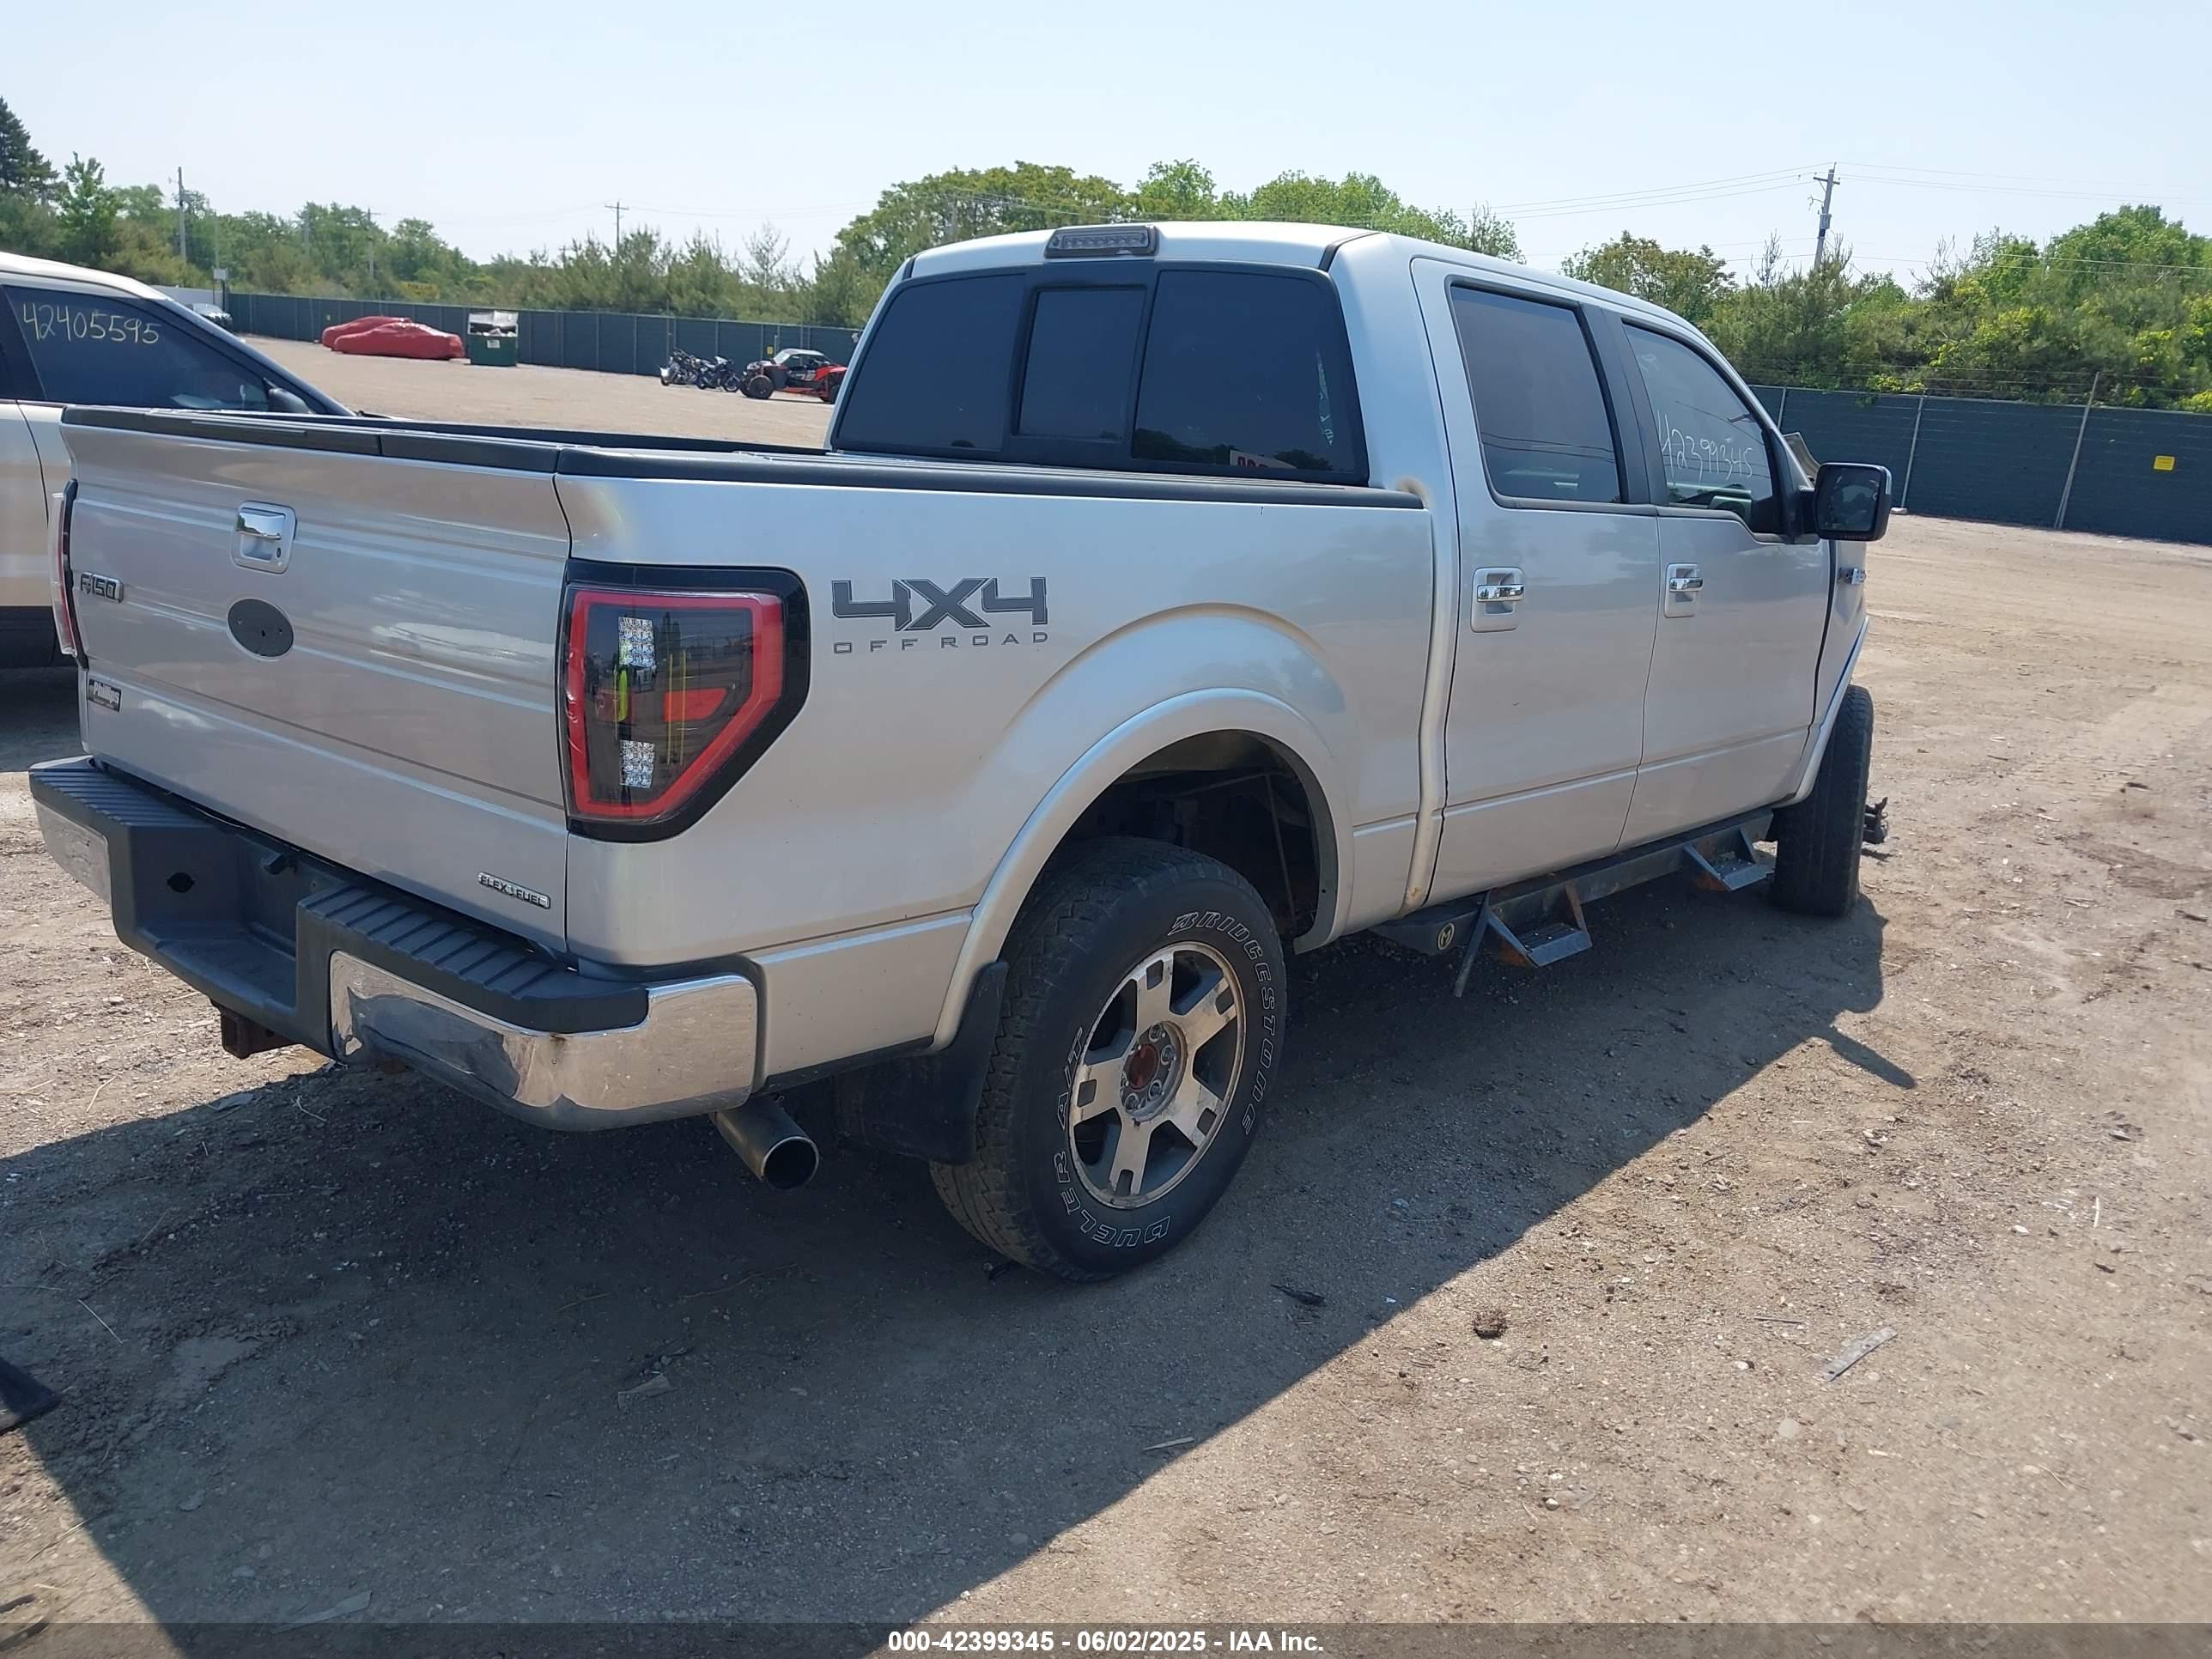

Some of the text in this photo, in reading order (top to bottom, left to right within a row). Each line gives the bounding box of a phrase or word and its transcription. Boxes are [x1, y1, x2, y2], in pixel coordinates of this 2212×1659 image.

[22, 302, 161, 345] 42405595
[1168, 911, 1277, 1135] BRIDGESTONE
[1053, 1151, 1172, 1248] DUELER
